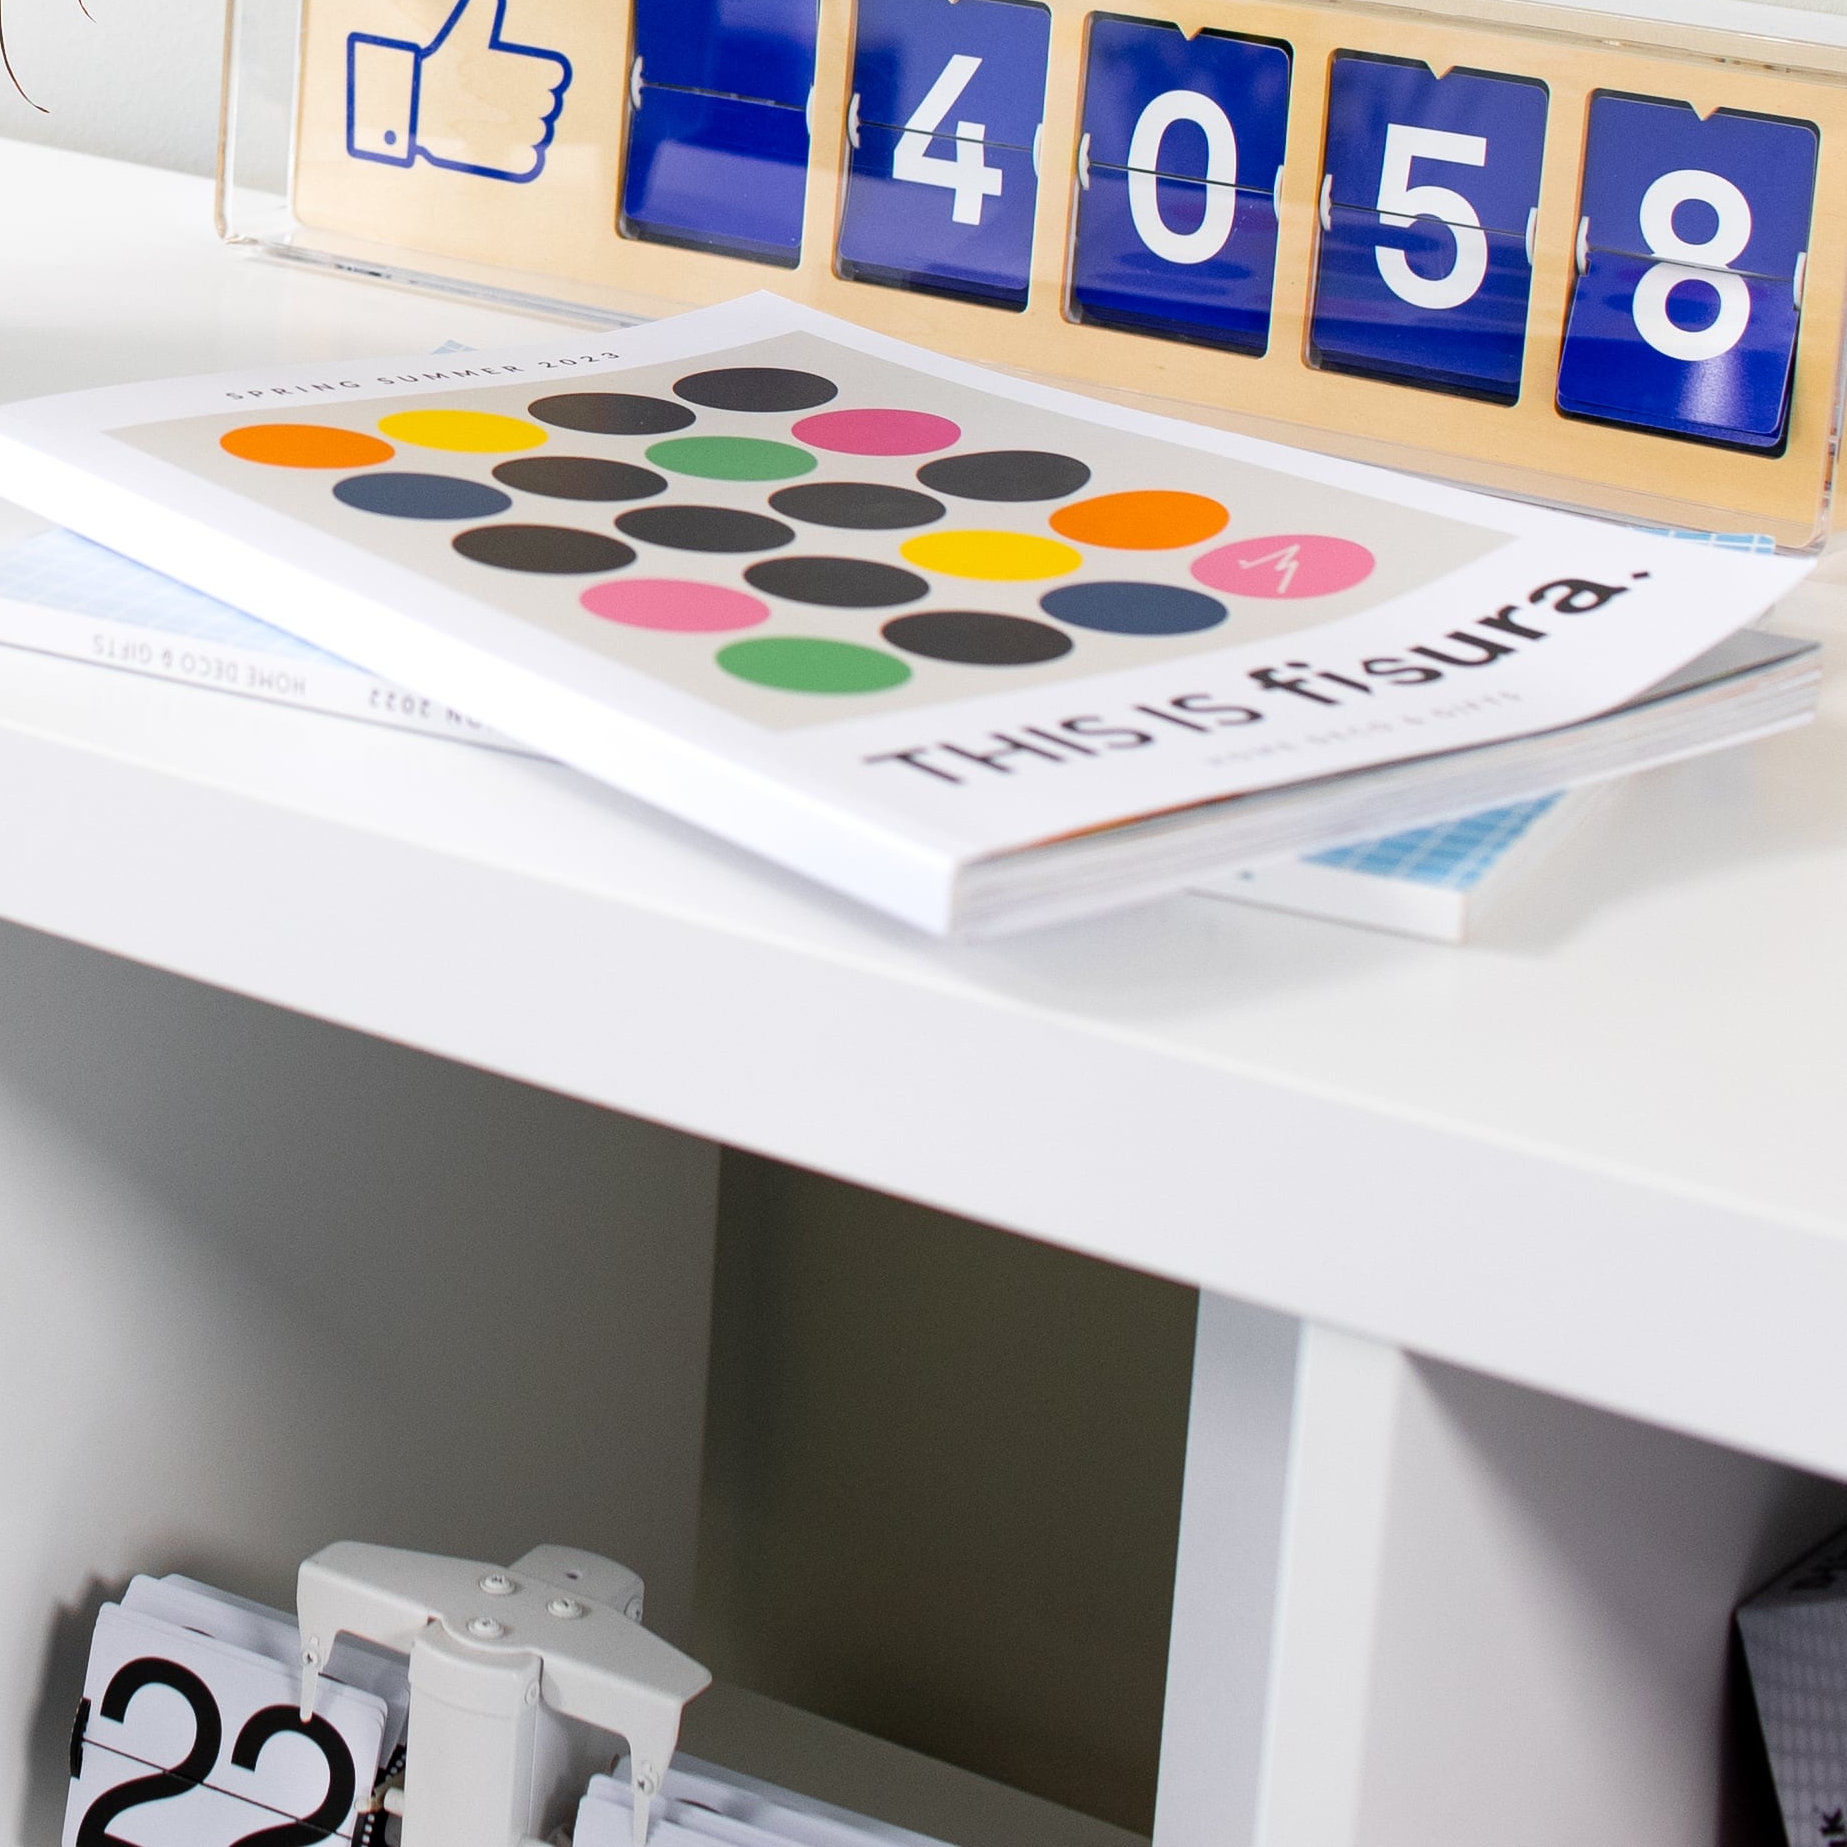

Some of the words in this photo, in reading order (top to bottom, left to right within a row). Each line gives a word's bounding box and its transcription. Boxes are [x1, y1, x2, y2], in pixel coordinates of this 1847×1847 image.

[893, 52, 1752, 362] 4058
[225, 378, 361, 401] SPRING
[376, 364, 525, 386] SUMMER
[537, 350, 622, 370] 2023
[91, 634, 155, 666] GIFTS
[179, 653, 240, 684] DECO
[247, 667, 308, 695] HOME
[861, 713, 1158, 788] THIS
[1133, 692, 1265, 734] IS
[1245, 569, 1655, 708] fisura.
[368, 688, 433, 720] 2022
